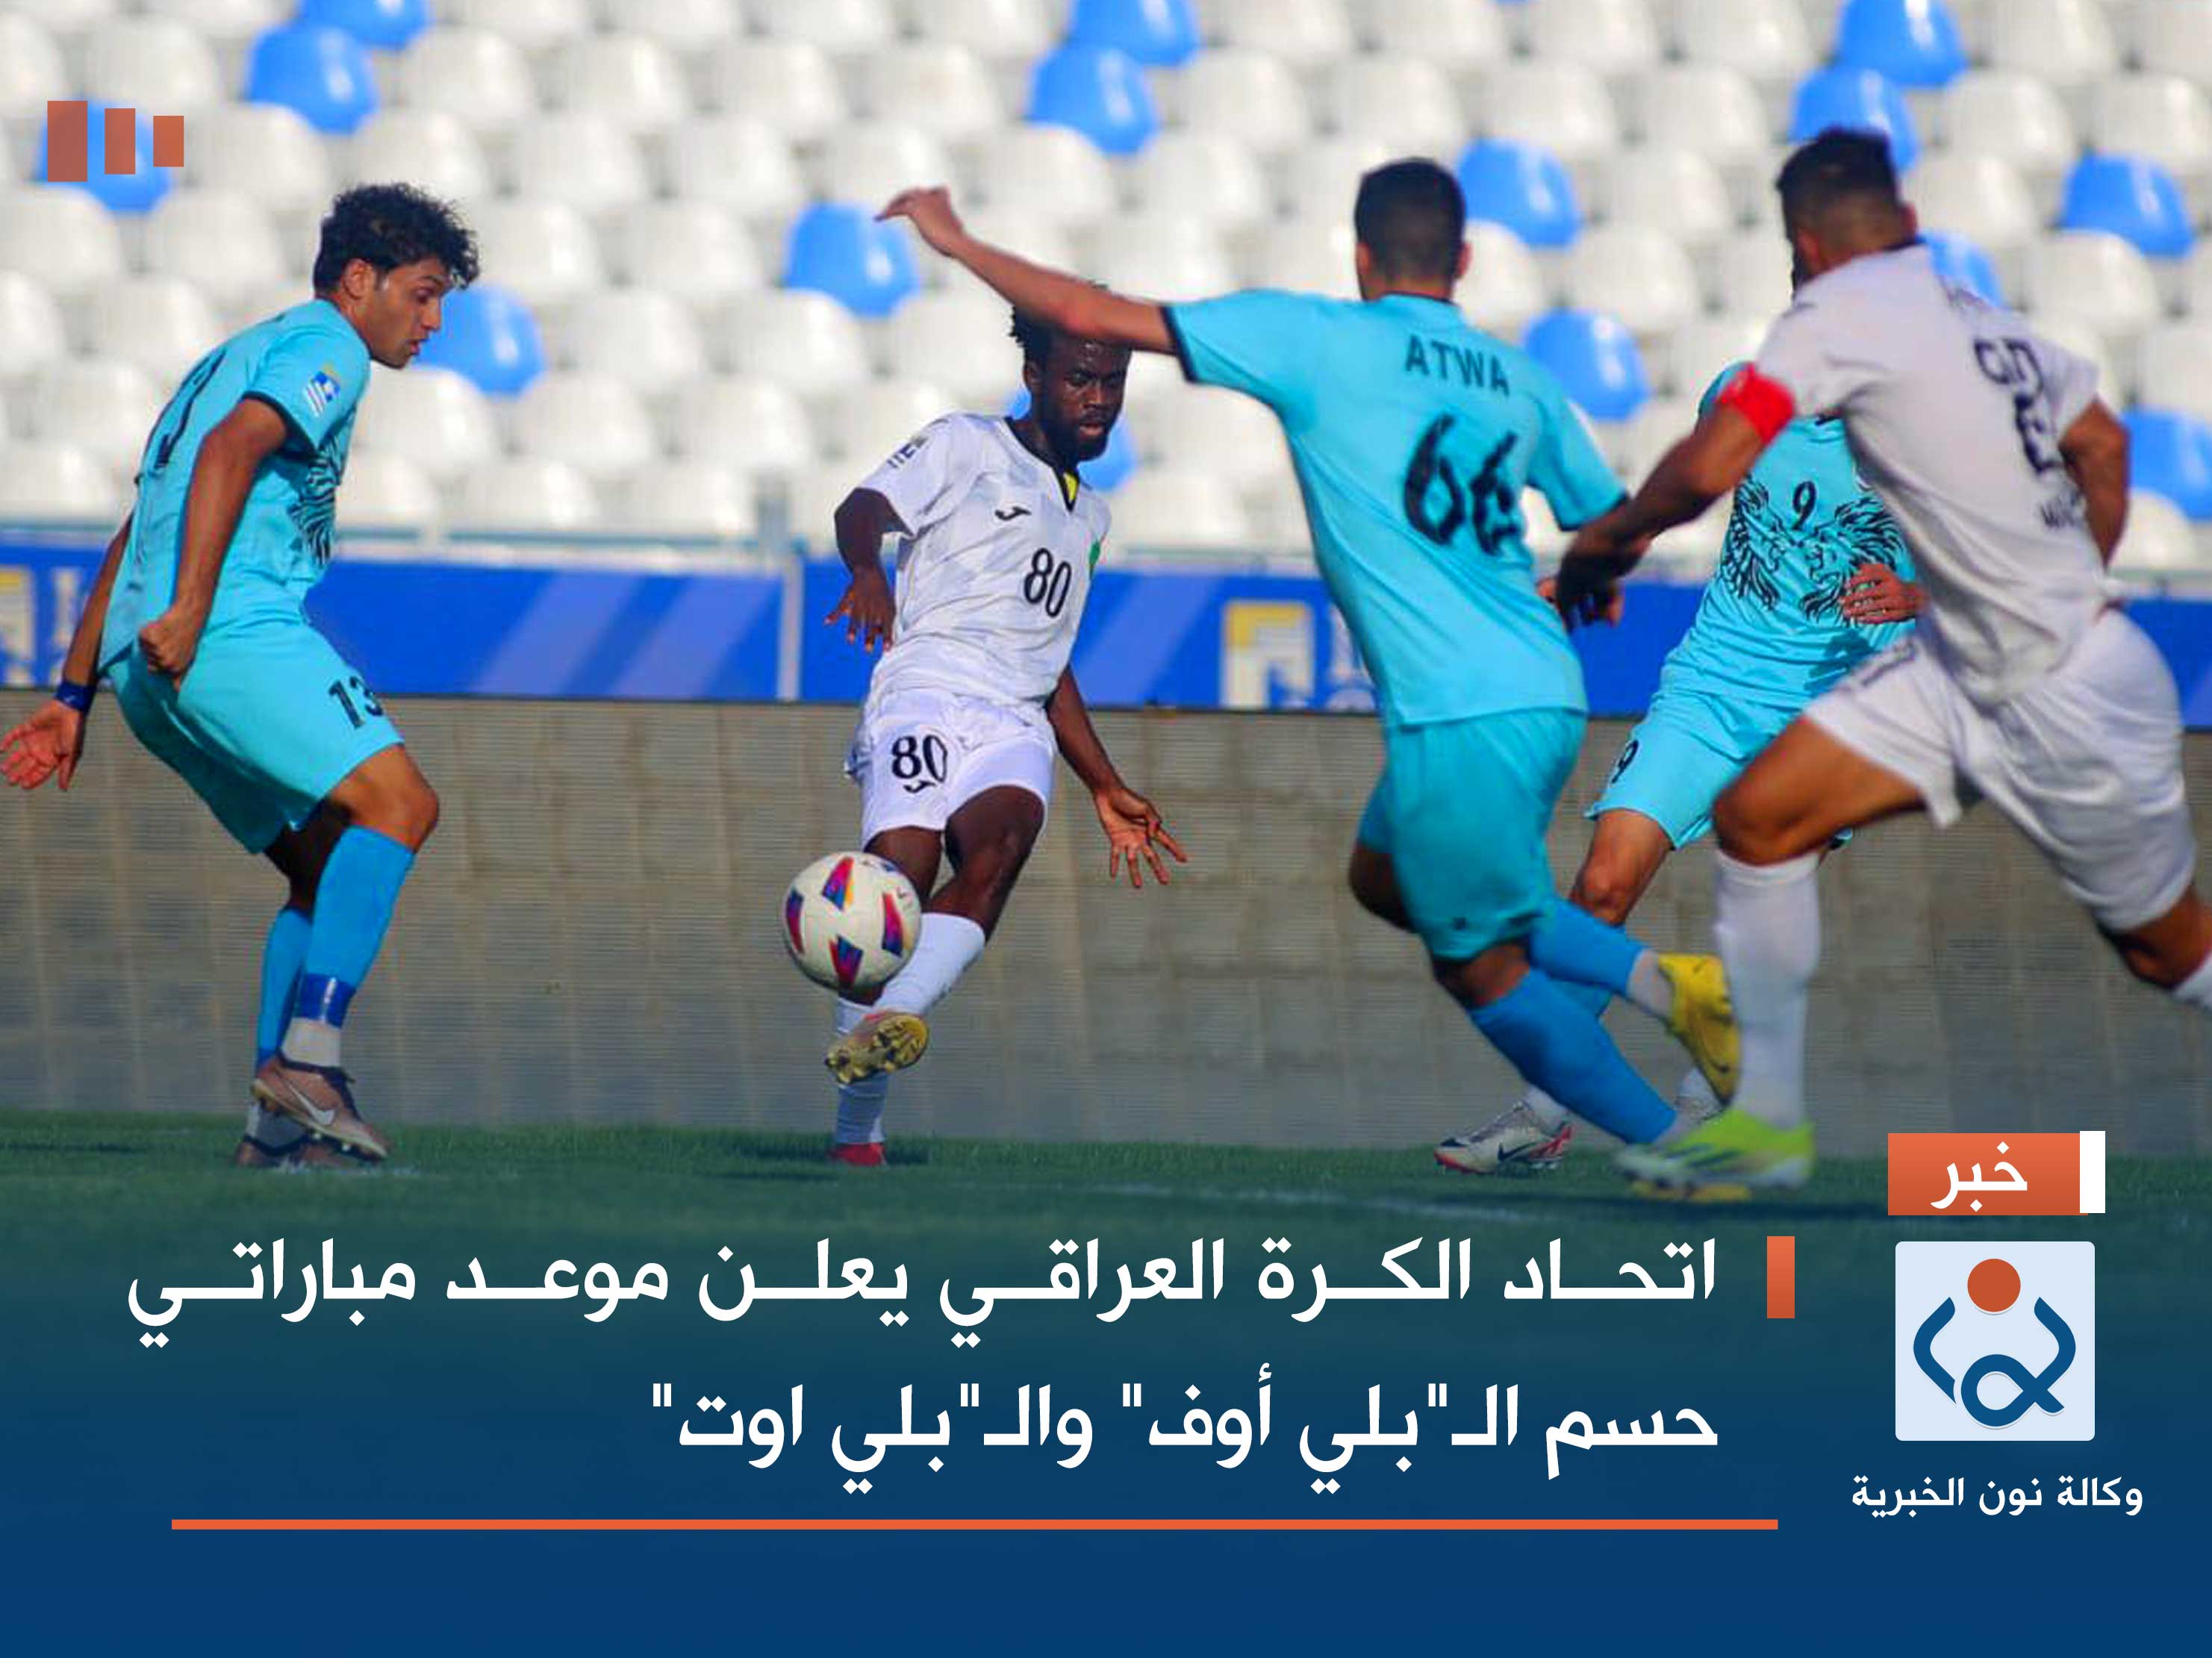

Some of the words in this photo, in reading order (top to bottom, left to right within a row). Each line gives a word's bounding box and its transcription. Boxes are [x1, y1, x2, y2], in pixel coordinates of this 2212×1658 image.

[1405, 334, 1511, 397] ATWA
[1403, 414, 1521, 557] 66
[1792, 481, 1817, 531] 9
[1024, 547, 1073, 618] 80
[328, 676, 384, 730] 13
[891, 735, 948, 783] 80
[1611, 739, 1639, 784] 9
